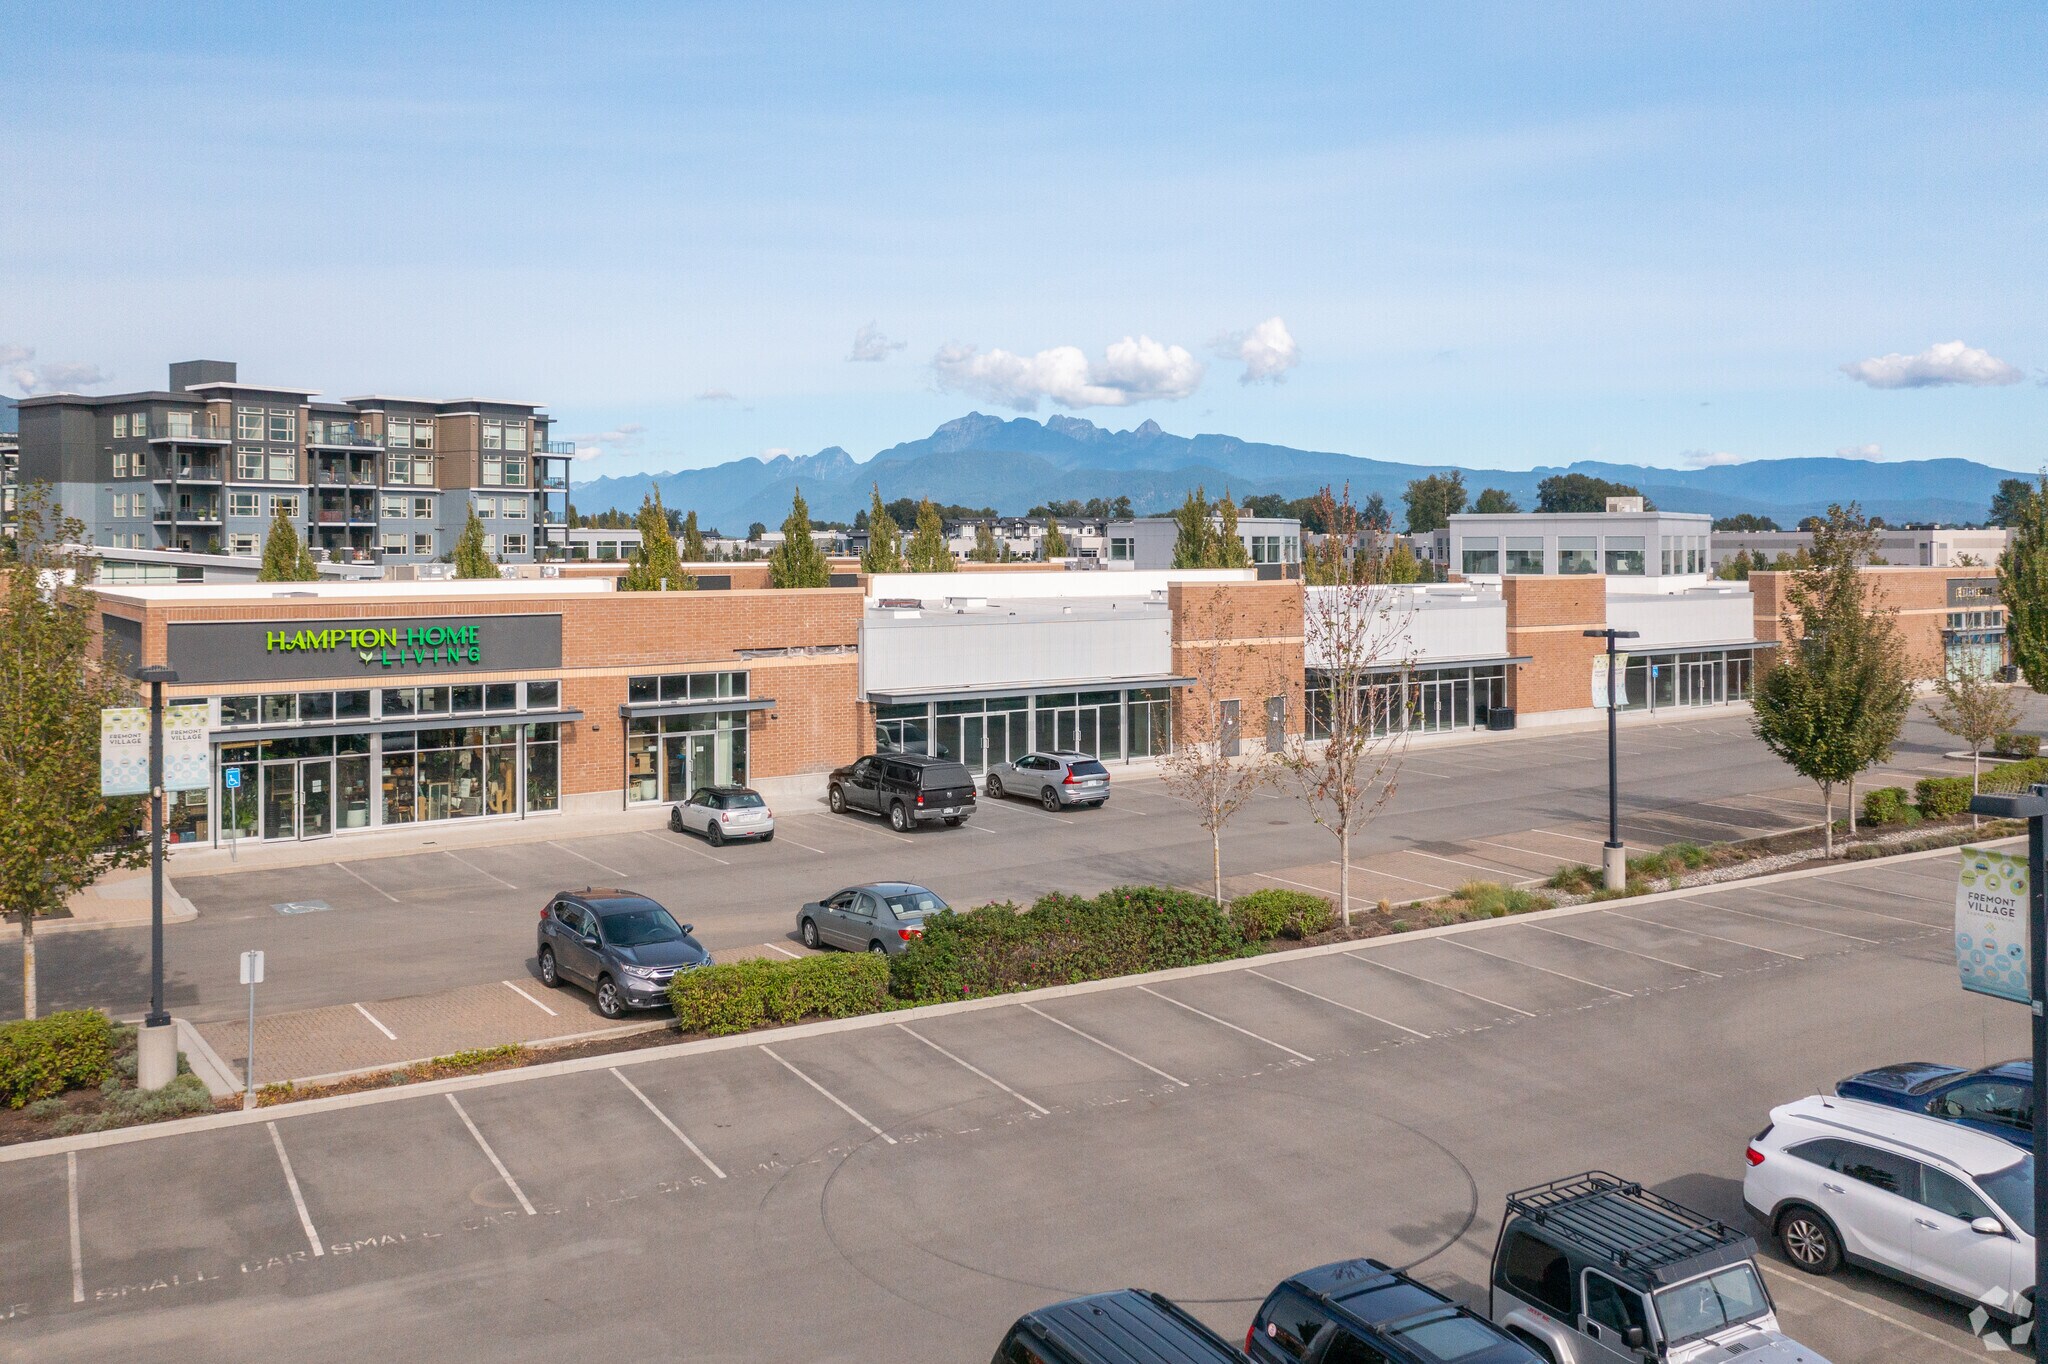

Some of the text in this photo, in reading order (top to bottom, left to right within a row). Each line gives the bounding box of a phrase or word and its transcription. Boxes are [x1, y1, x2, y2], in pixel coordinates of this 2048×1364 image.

[266, 625, 481, 650] HAMPTON HOME
[381, 648, 481, 666] LIVING
[1968, 891, 2016, 906] FREMONT
[1967, 901, 2015, 918] VILLAGE
[331, 1232, 444, 1255] SMALL
[95, 1250, 306, 1301] SMALL CAR
